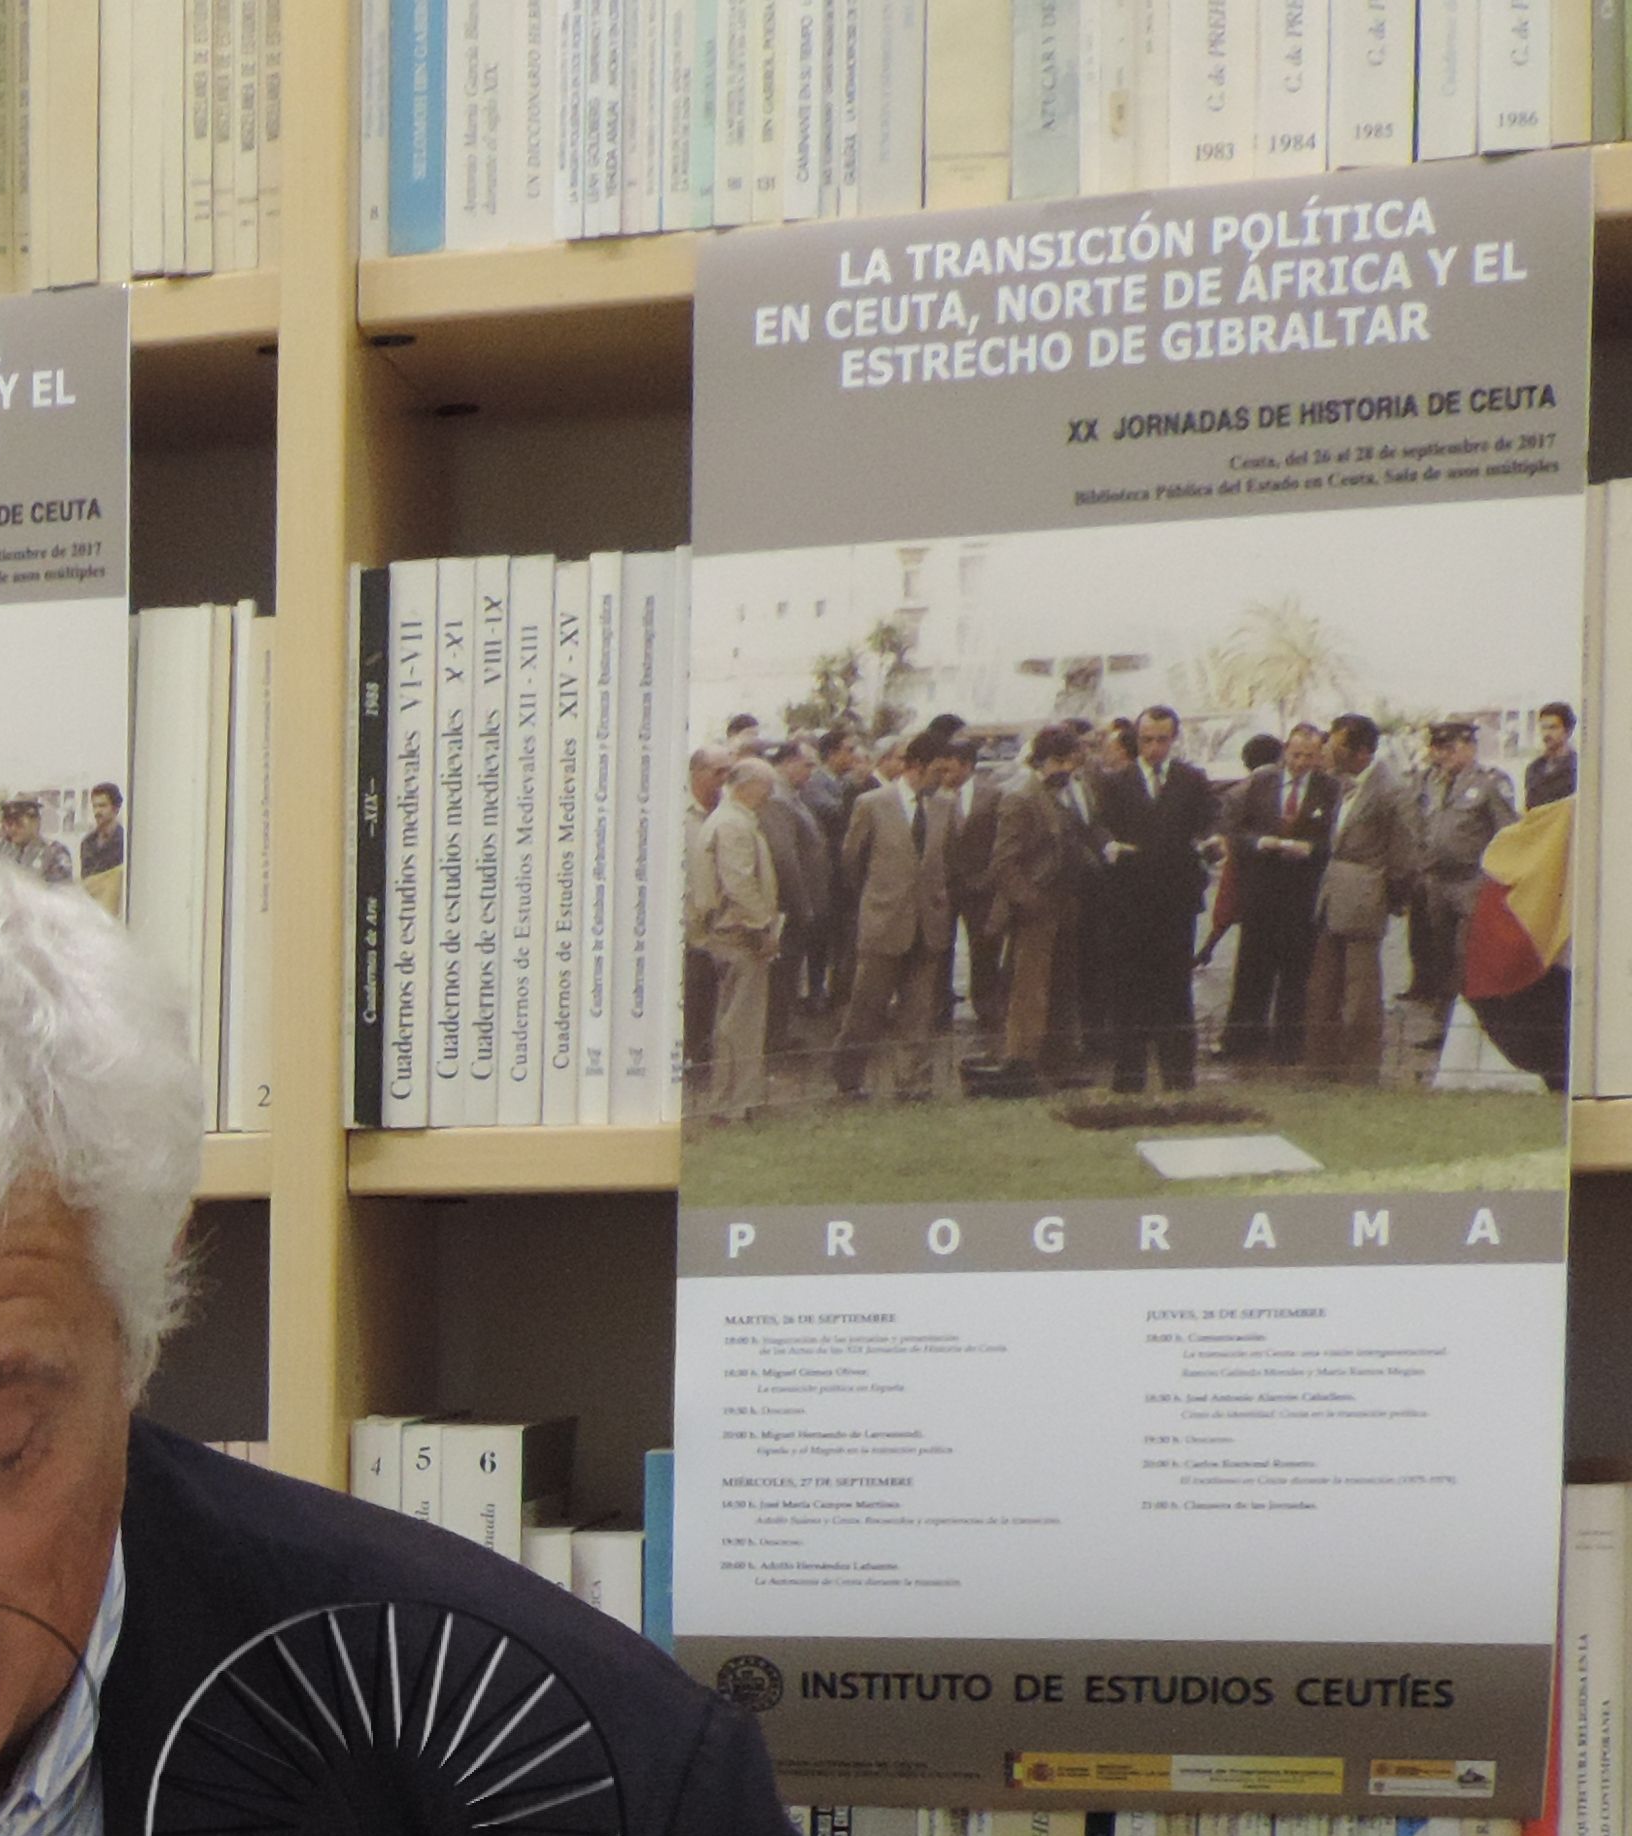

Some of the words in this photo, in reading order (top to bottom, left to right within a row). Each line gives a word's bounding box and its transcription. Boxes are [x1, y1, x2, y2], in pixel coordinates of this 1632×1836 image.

[839, 247, 892, 288] LA
[905, 219, 1195, 281] TRANSICIÓN
[1212, 197, 1436, 256] POLÍTICA
[755, 304, 810, 346] EN
[825, 289, 980, 339] CEUTA,
[997, 273, 1147, 325] NORTE
[1163, 266, 1223, 310] DE
[1236, 250, 1413, 304] ÁFRICA
[1427, 245, 1458, 287] Y
[1473, 241, 1528, 284] EL
[841, 331, 1073, 388] ESTRECHO
[1088, 324, 1147, 368] DE
[1161, 301, 1430, 361] GIBRALTAR
[32, 368, 76, 408] EL
[1066, 418, 1099, 445] XX
[1113, 405, 1250, 441] JORNADAS
[1258, 403, 1291, 429] DE
[1299, 394, 1419, 426] HISTORIA
[1427, 390, 1462, 417] DE
[1469, 383, 1557, 414] CEUTA
[30, 497, 101, 524] CEUTA
[559, 612, 580, 647] XV
[558, 672, 579, 719] XIV
[397, 730, 422, 849] medievales
[557, 738, 577, 843] Medievales
[395, 851, 419, 946] estudios
[555, 851, 575, 933] Estudios
[393, 949, 416, 975] de
[555, 940, 573, 963] de
[389, 981, 417, 1101] Cuadernos
[552, 969, 572, 1070] Cuadernos
[801, 1671, 993, 1703] INSTITUTO
[1013, 1673, 1064, 1704] DE
[1084, 1675, 1275, 1707] ESTUDIOS
[1295, 1673, 1455, 1709] CEUTÍES
